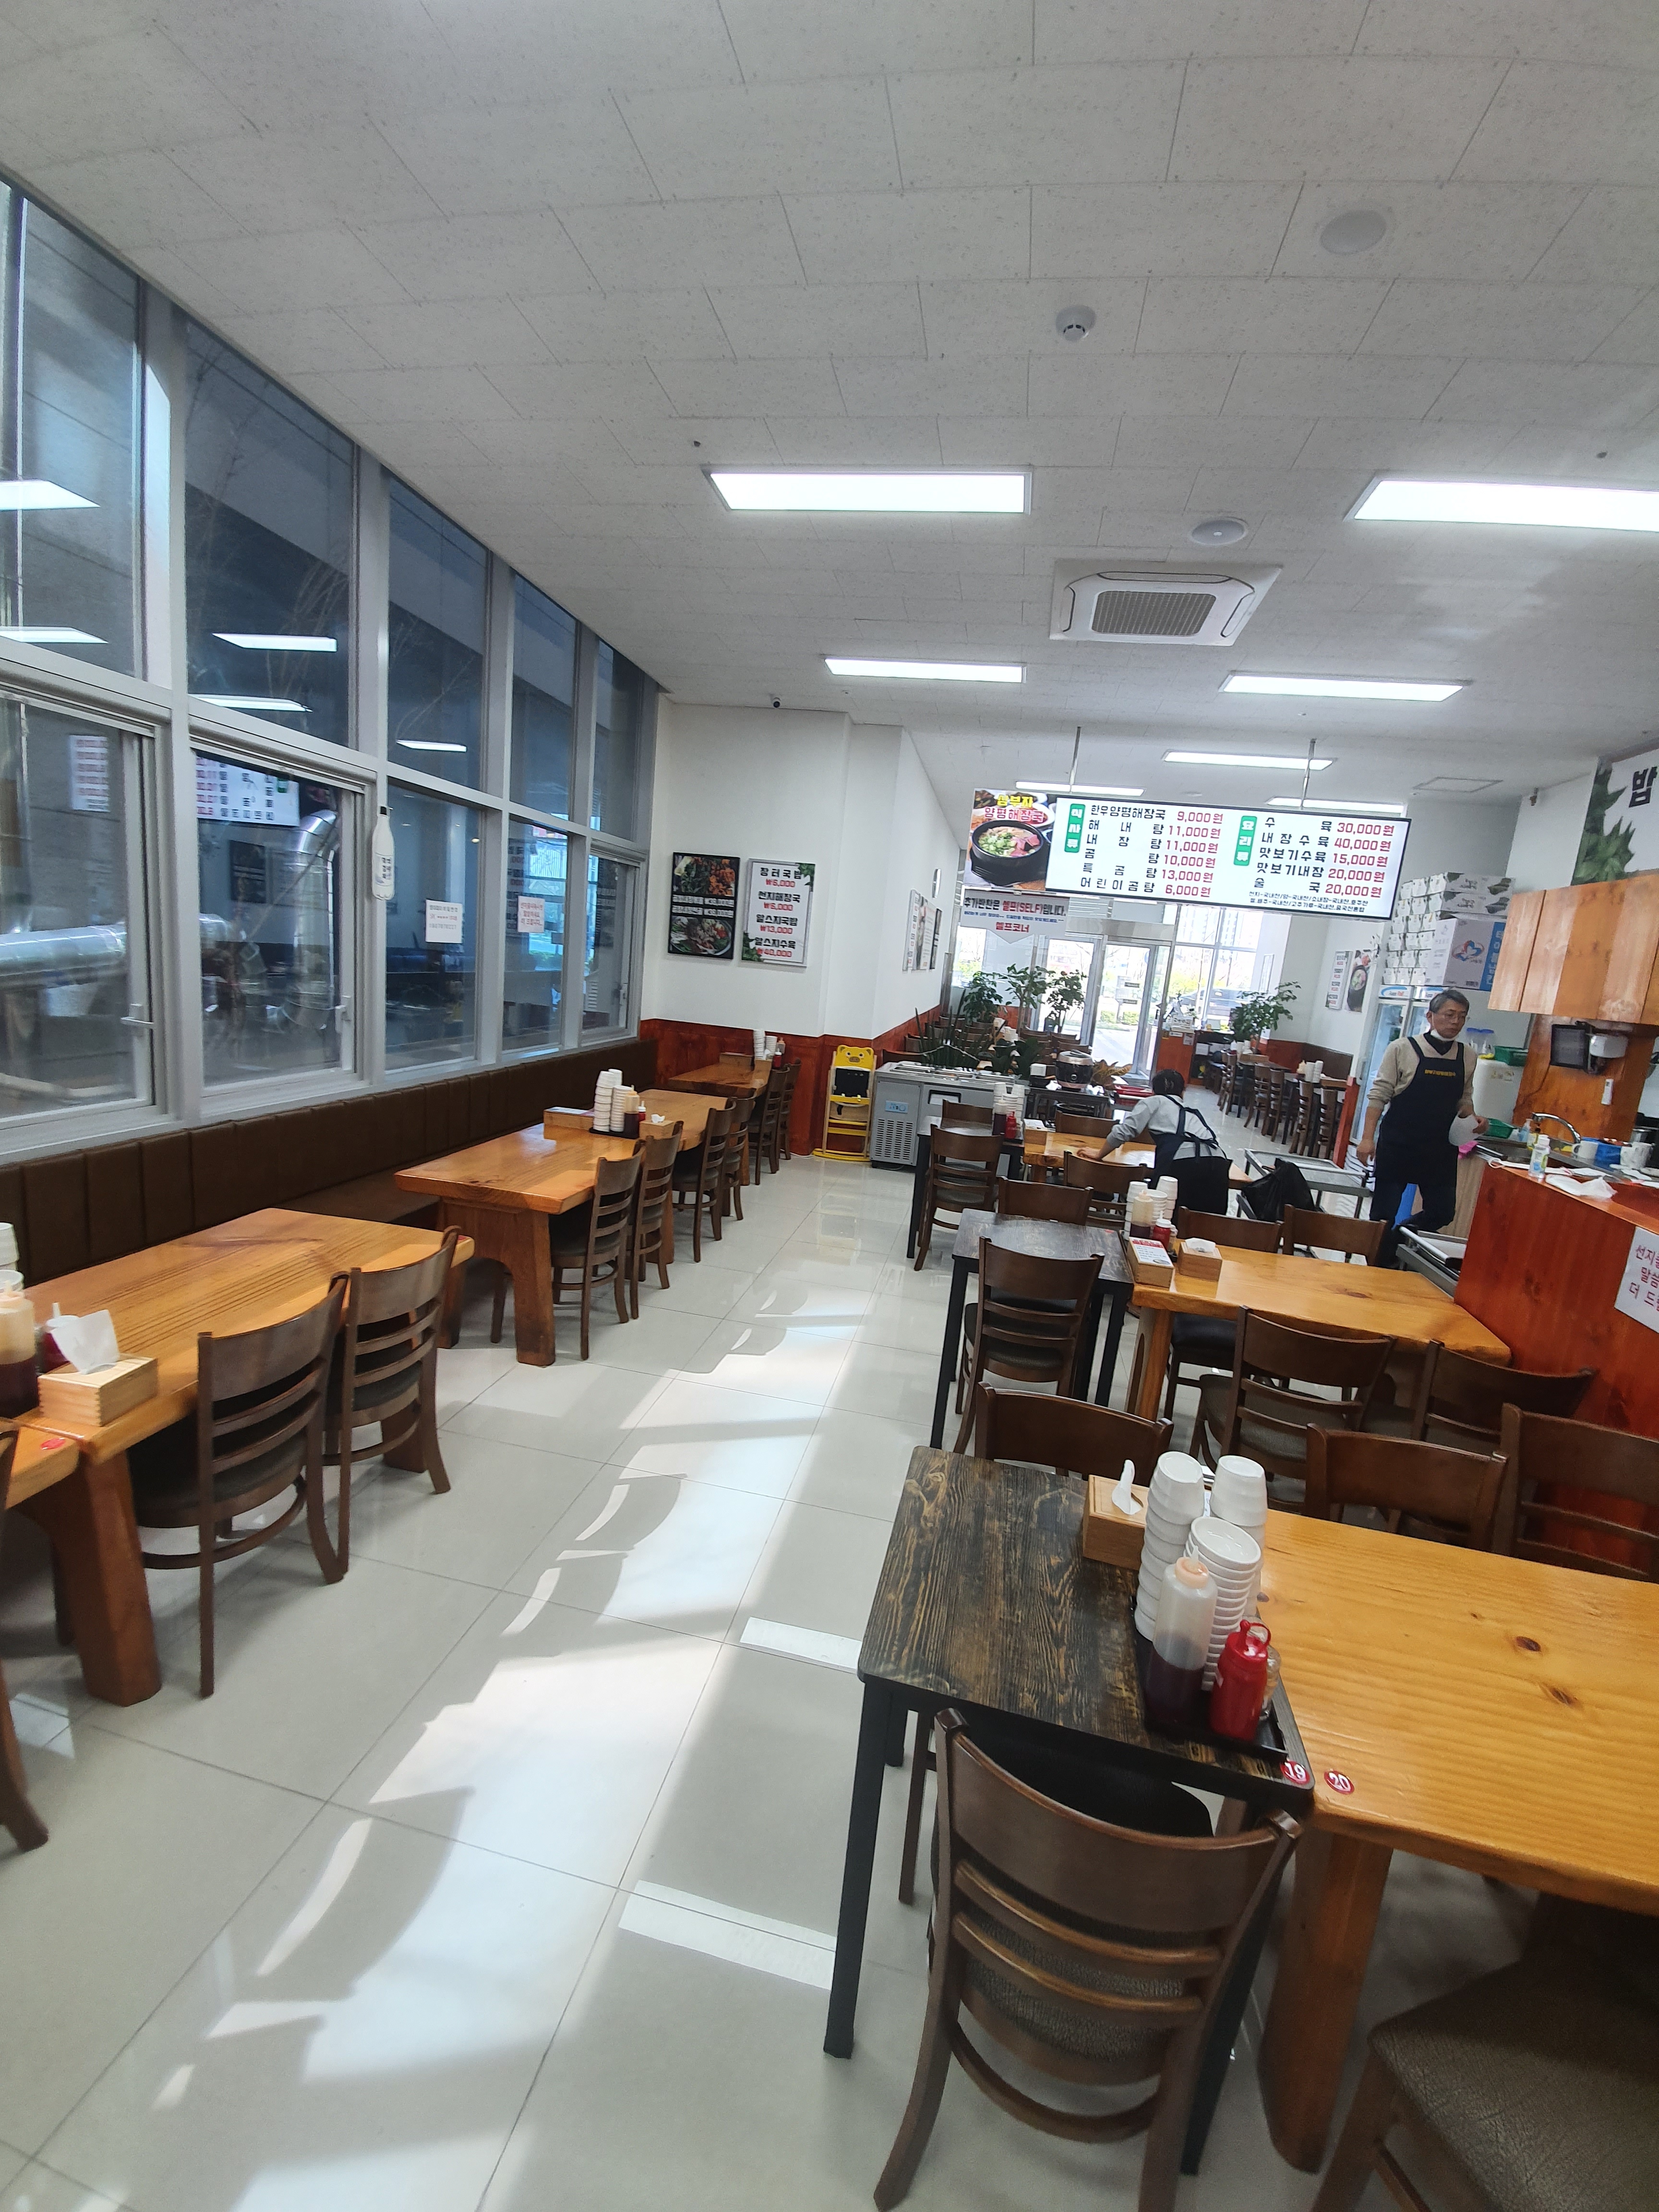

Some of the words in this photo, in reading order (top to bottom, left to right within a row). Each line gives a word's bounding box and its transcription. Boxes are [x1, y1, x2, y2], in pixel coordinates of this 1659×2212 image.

[997, 794, 1034, 808] 삼부자
[984, 806, 1044, 823] 양평해장국
[1091, 805, 1166, 820] 한우양평해장국
[1177, 811, 1223, 824] 9,000원
[1168, 825, 1221, 839] 11,000원
[1337, 822, 1395, 836] 30,000원
[1166, 840, 1218, 854] 11,000원
[1334, 838, 1391, 852] 40,000원
[1164, 854, 1215, 868] 10,000원
[1259, 847, 1326, 863] 맛보기수육
[1333, 853, 1388, 867] 15,000원
[1162, 869, 1214, 883] 13,000원
[1257, 862, 1324, 878] 맛보기내장
[1328, 868, 1385, 883] 20,000원
[758, 891, 800, 903] 선지해장국
[1165, 884, 1211, 897] 6,000원
[1325, 884, 1382, 898] 20,000원
[964, 897, 1000, 910] 추가반찬은
[996, 921, 1030, 933] 셀프코너
[1629, 1282, 1640, 1299] 더
[1284, 1762, 1306, 1781] 19
[1329, 1772, 1351, 1791] 20
